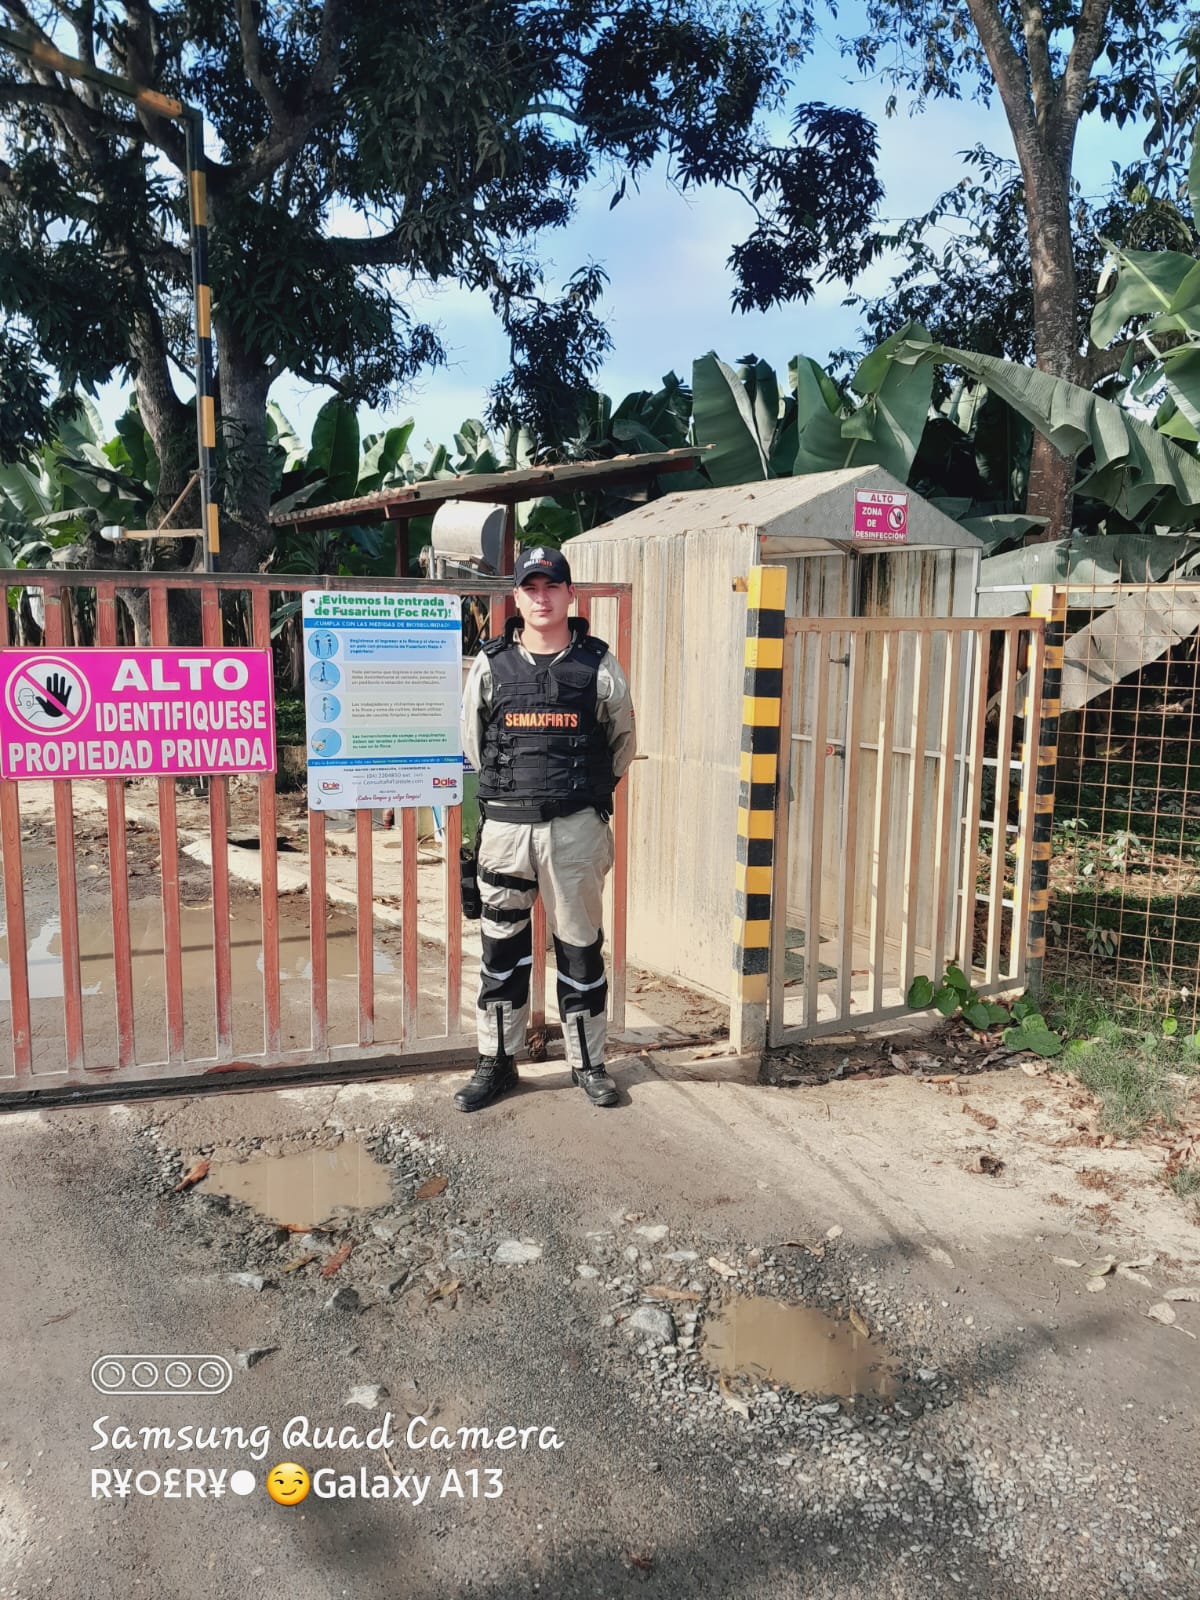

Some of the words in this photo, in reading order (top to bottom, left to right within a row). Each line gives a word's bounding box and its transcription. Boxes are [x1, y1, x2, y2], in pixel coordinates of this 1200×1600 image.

[871, 494, 893, 503] ALTO
[862, 506, 882, 516] ZONA
[866, 519, 876, 528] DE
[319, 595, 381, 606] ¡Evitemos
[384, 596, 394, 606] la
[397, 596, 444, 606] entrada
[314, 606, 330, 616] de
[332, 606, 391, 617] Fusarium
[394, 608, 418, 618] (Foc
[422, 608, 452, 618] R4T)!
[112, 658, 248, 692] ALTO
[96, 700, 266, 732] IDENTIFIQUESE
[505, 712, 578, 728] SEMAXFIRTS
[8, 739, 152, 772] PROPIEDAD
[162, 737, 266, 768] PRIVADA
